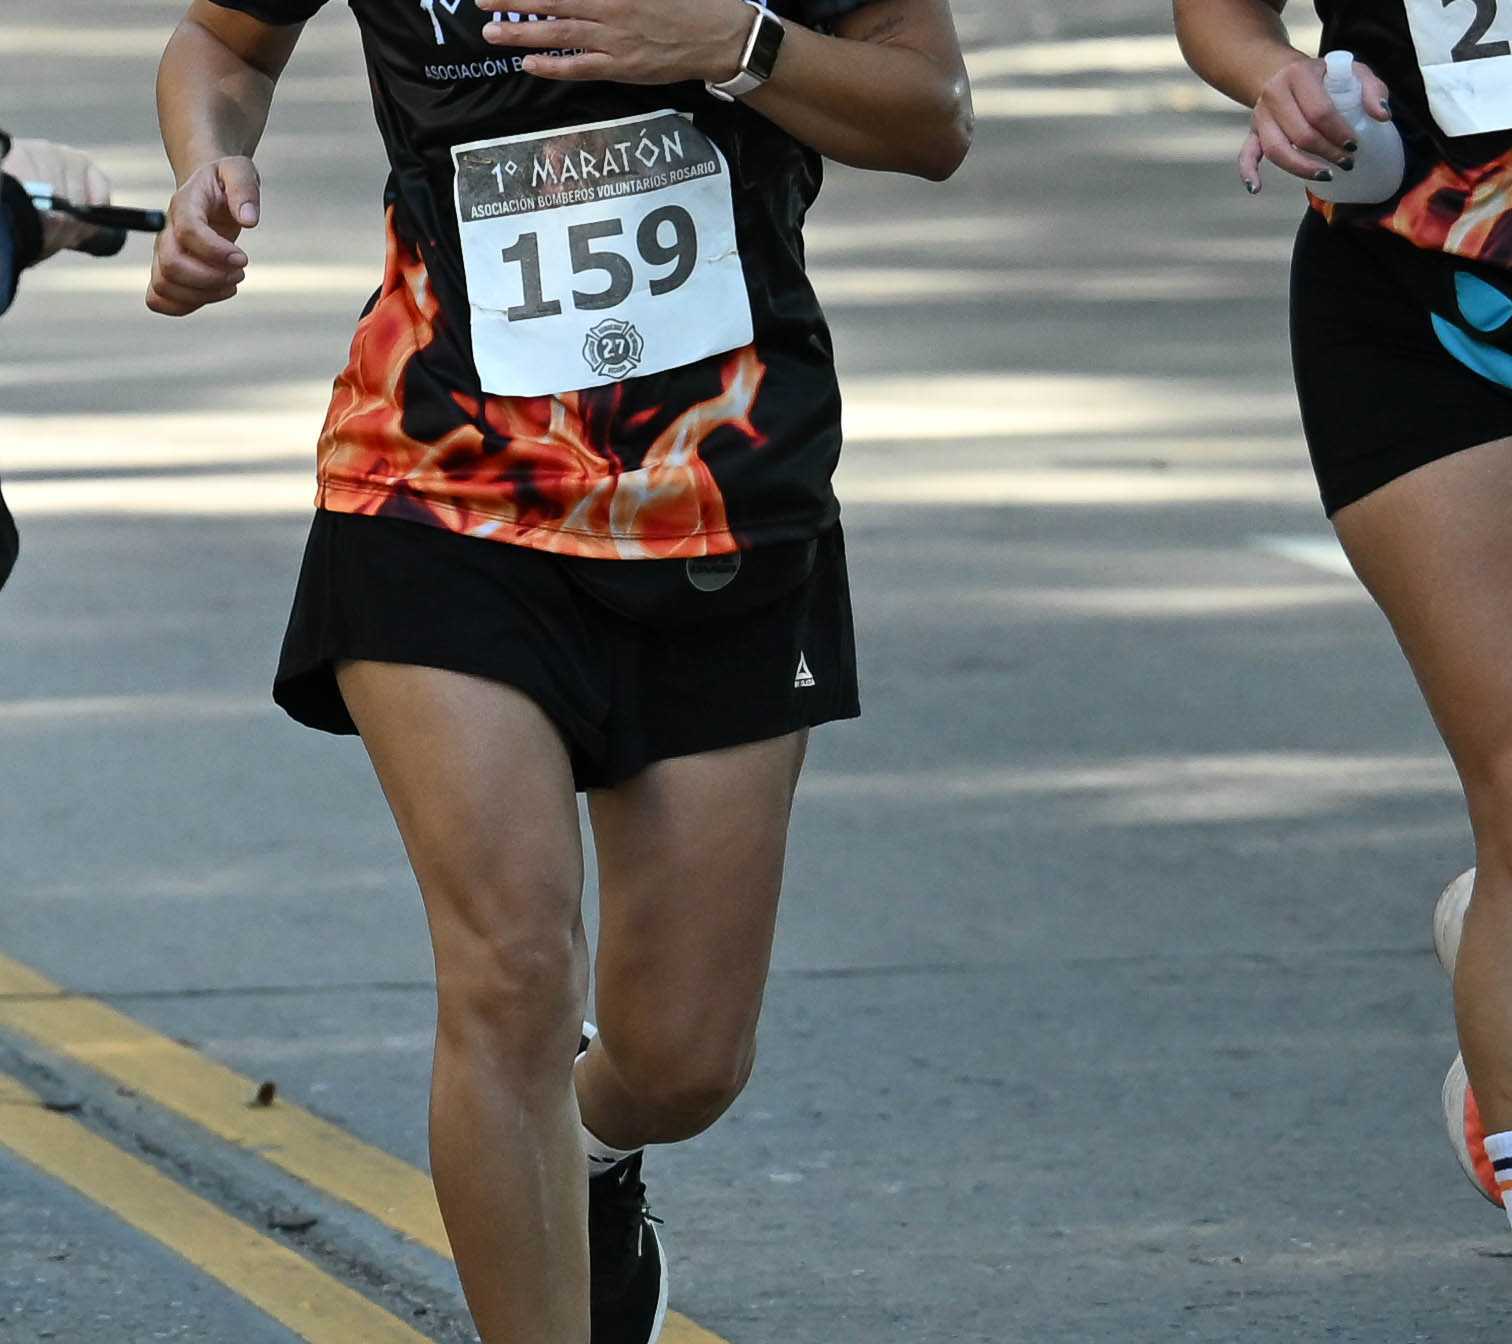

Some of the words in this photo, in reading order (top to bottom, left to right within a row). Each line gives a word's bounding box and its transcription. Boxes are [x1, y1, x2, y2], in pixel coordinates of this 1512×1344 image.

[531, 128, 684, 188] MARATÓN
[537, 187, 595, 208] BOMBEROS
[596, 173, 667, 198] VOLUNTARIOS
[669, 160, 716, 184] ROSARIO
[501, 205, 698, 322] 159
[602, 338, 625, 359] 27
